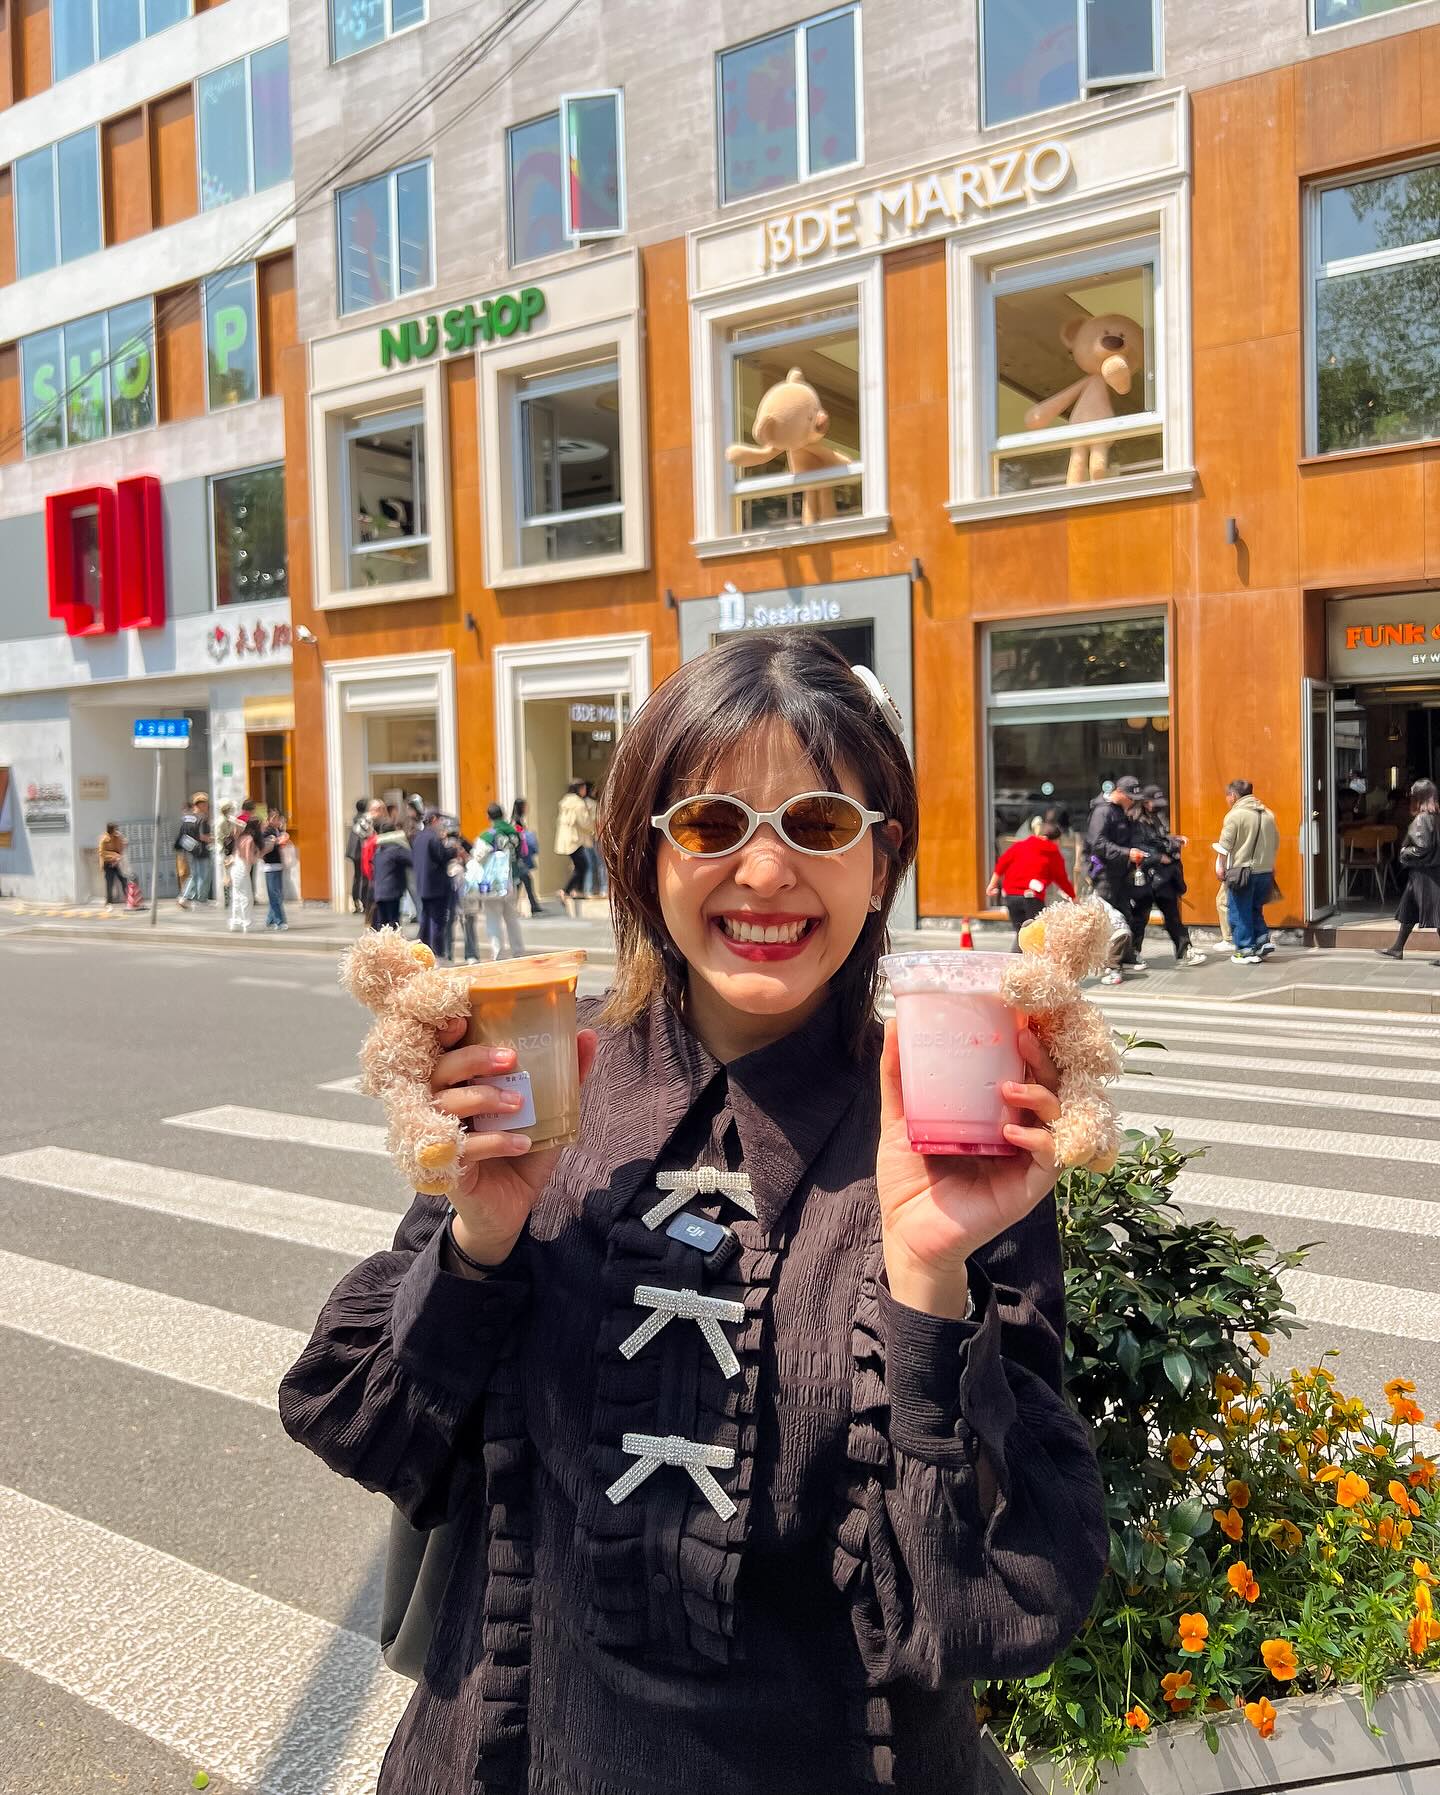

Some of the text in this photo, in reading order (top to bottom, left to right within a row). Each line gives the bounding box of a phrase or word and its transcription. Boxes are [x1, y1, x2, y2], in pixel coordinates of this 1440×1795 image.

[874, 140, 1071, 240] MARZO
[443, 287, 546, 351] SHOP
[1345, 623, 1425, 649] FUNK
[1412, 654, 1426, 663] BY
